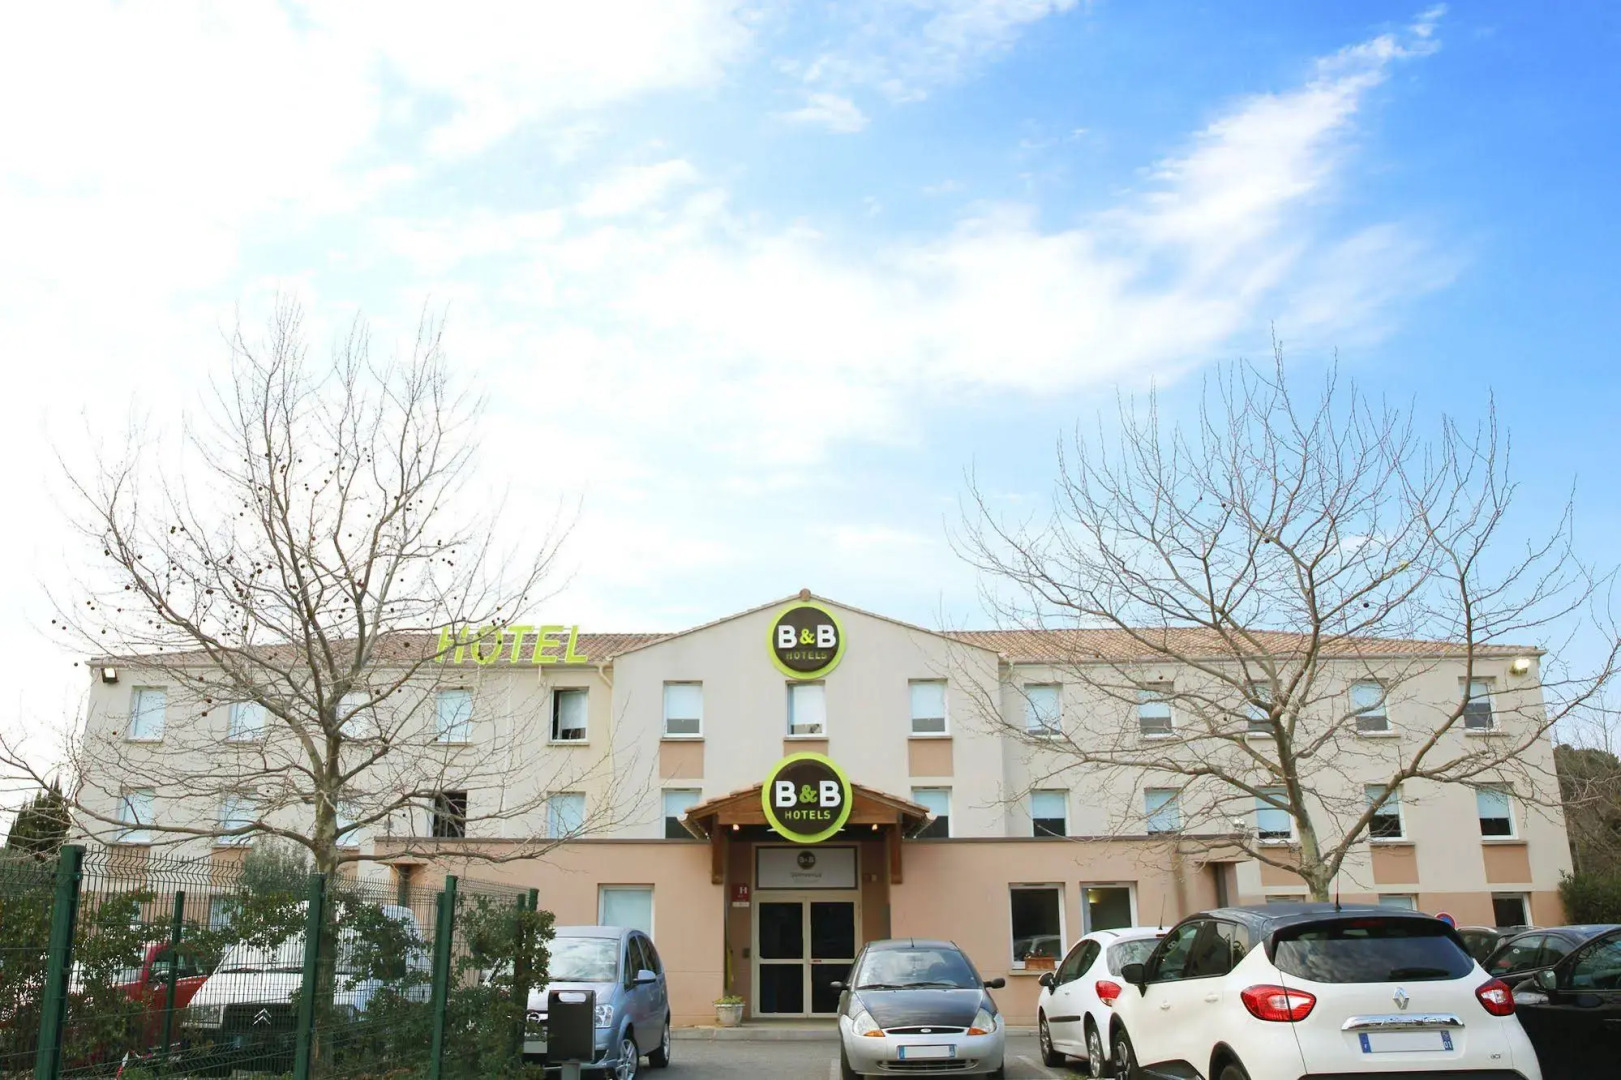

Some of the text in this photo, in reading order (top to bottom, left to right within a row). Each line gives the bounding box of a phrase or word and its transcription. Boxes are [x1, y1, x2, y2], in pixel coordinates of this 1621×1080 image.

[435, 625, 588, 664] HOTEL
[778, 624, 836, 648] B&B
[786, 651, 827, 660] HOTELS
[775, 780, 841, 807] B&B
[783, 810, 831, 820] HOTELS
